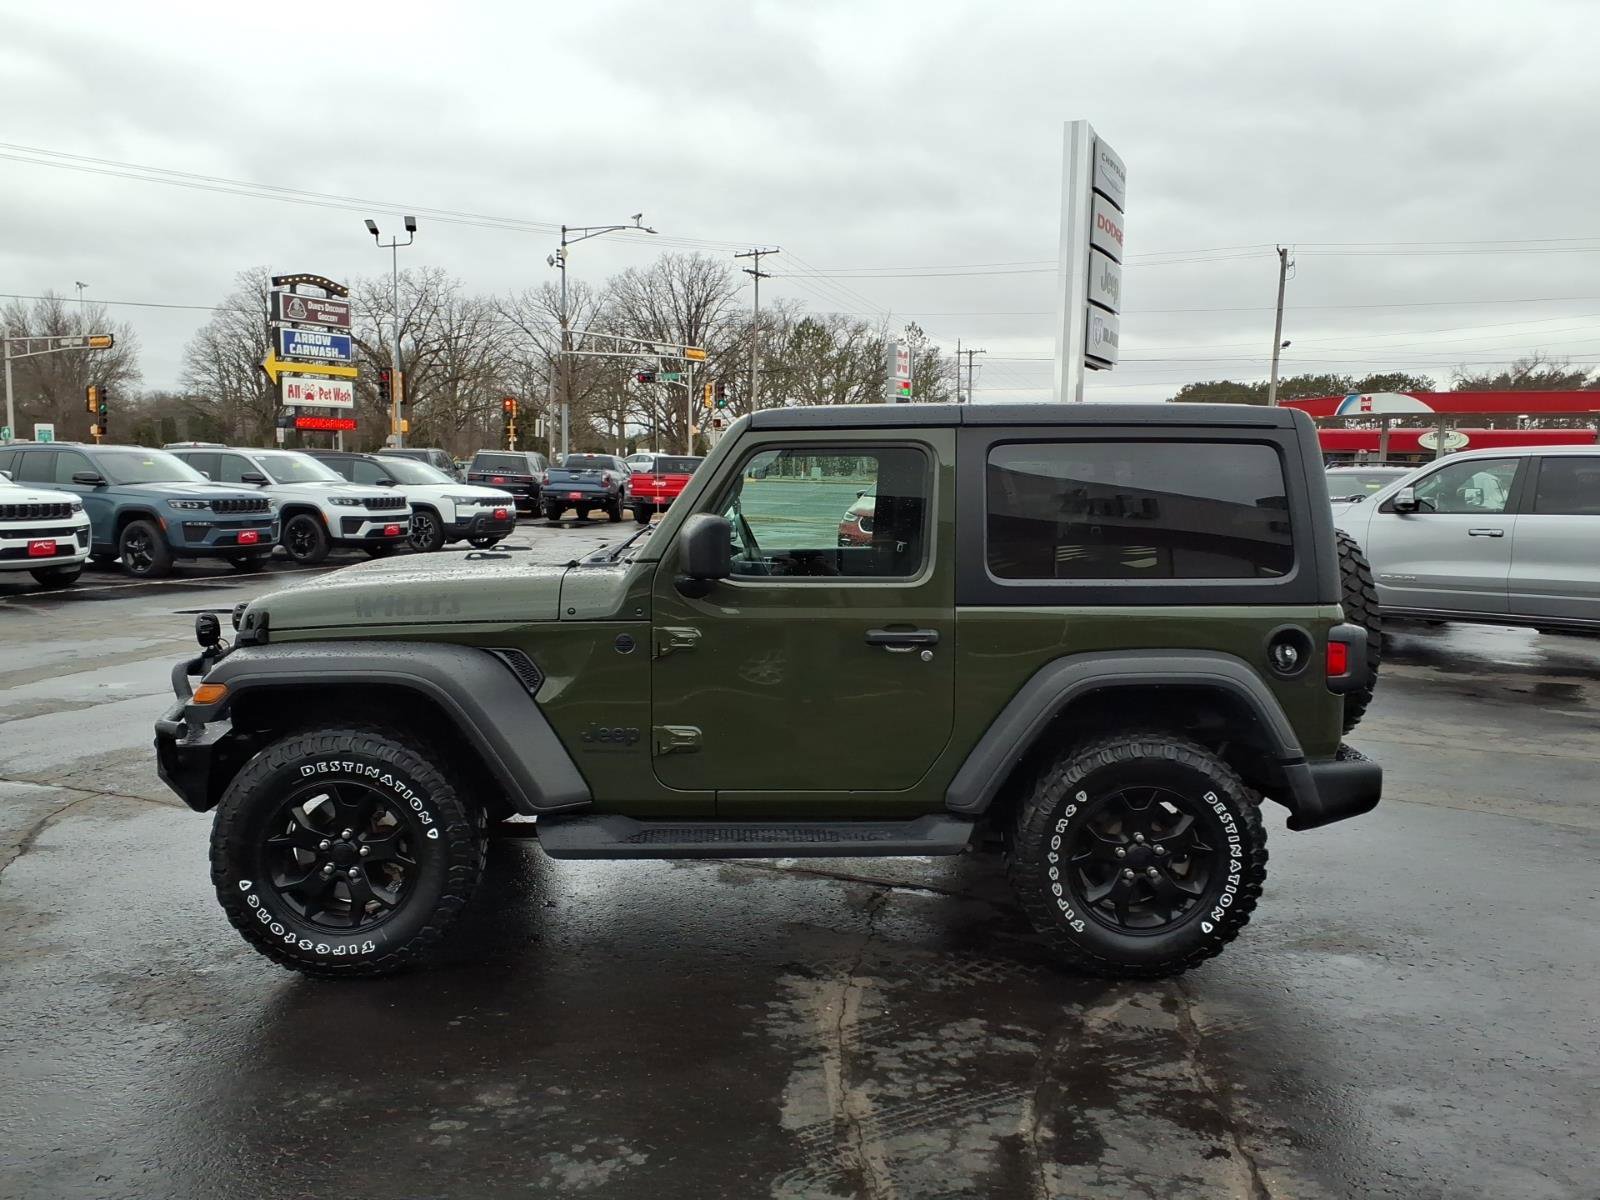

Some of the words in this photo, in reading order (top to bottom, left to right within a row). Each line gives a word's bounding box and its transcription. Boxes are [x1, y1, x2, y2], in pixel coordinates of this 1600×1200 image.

[1097, 212, 1123, 248] DODGE
[1100, 261, 1119, 305] Jeep
[294, 332, 331, 346] ARROW
[288, 384, 301, 399] All
[318, 386, 332, 400] Pet
[333, 387, 352, 402] Wash
[581, 721, 640, 748] Jeep
[300, 761, 433, 825] DESTINATION
[1203, 791, 1243, 923] DESTINATION
